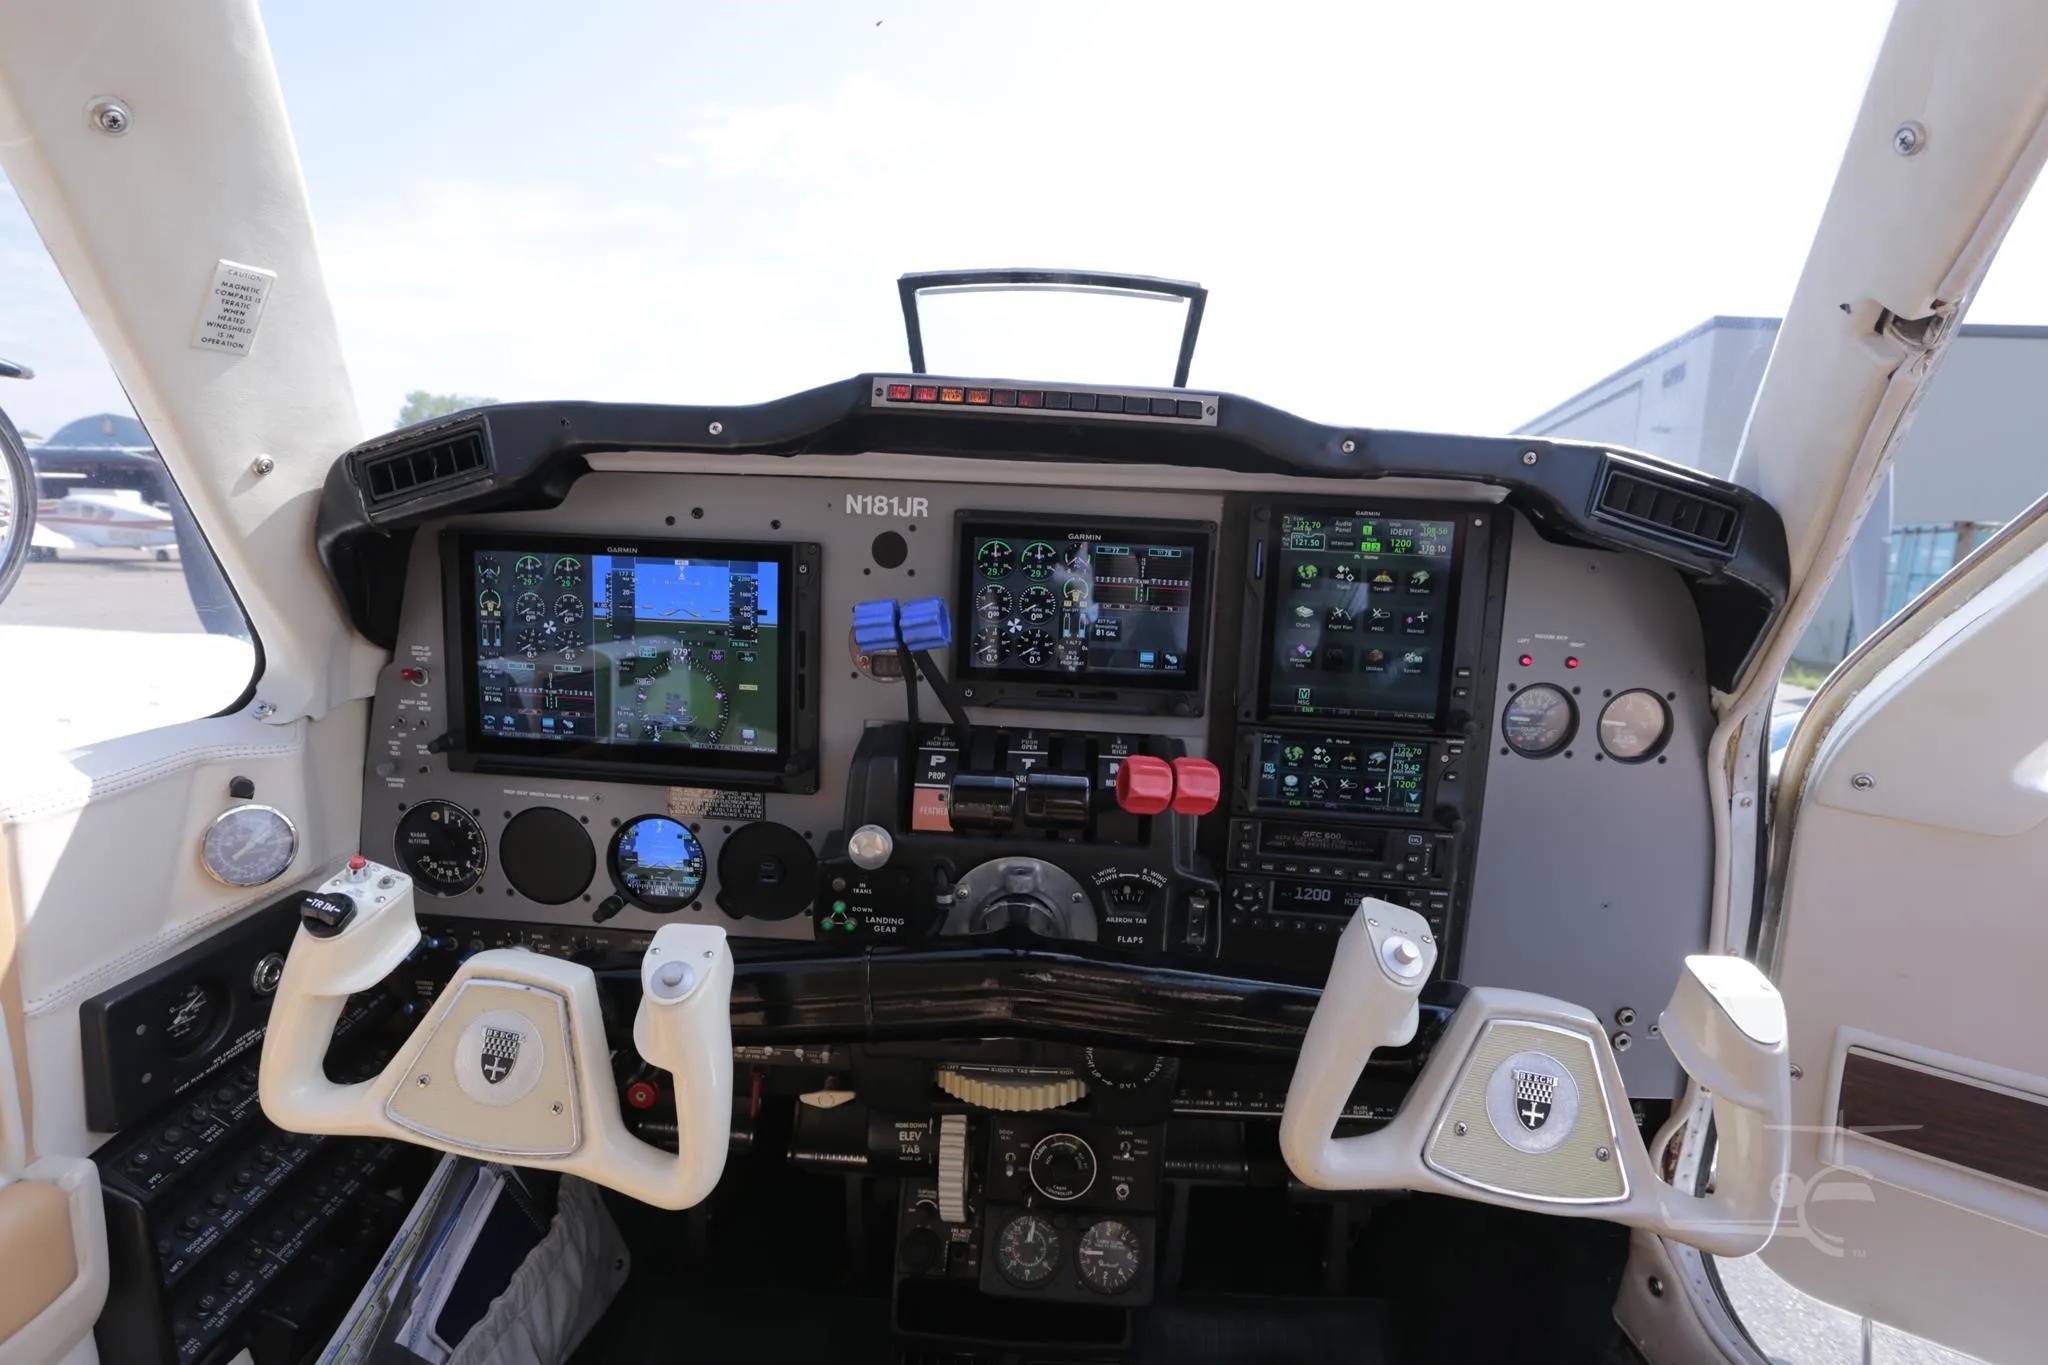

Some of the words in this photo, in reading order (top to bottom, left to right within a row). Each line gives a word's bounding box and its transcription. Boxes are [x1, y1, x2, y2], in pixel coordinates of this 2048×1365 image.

[221, 281, 260, 294] MAGNETIC
[215, 289, 252, 301] COMPASS
[221, 298, 251, 310] ERRATIC
[224, 308, 246, 316] WHEN
[218, 315, 245, 324] HEATED
[206, 321, 252, 334] WINDSHIELD
[201, 337, 244, 348] OPERATION
[846, 494, 928, 517] N181JR
[1391, 539, 1412, 547] 1200
[930, 755, 946, 766] P
[1022, 758, 1036, 770] T
[1396, 780, 1416, 788] 1200
[468, 832, 472, 840] 2
[1097, 867, 1116, 878] WING
[1150, 870, 1168, 884] WING
[1096, 873, 1118, 886] DOWN
[1142, 874, 1164, 888] DOWN
[1294, 887, 1331, 901] 1200
[311, 898, 335, 912] TRIM
[866, 916, 904, 926] LANDING
[1118, 936, 1143, 944] FLAPS
[487, 1029, 518, 1040] BEECH
[1520, 1072, 1552, 1084] BEECH
[206, 1128, 224, 1142] WARN
[899, 1131, 922, 1142] ELEV
[174, 1146, 192, 1160] STALL
[901, 1144, 920, 1154] TAB
[1034, 1145, 1048, 1160] CABIN
[178, 1148, 199, 1164] WARN
[148, 1173, 162, 1184] PFD
[184, 1237, 202, 1253] DOOR
[169, 1260, 184, 1273] MFD
[218, 1296, 238, 1316] BOOST
